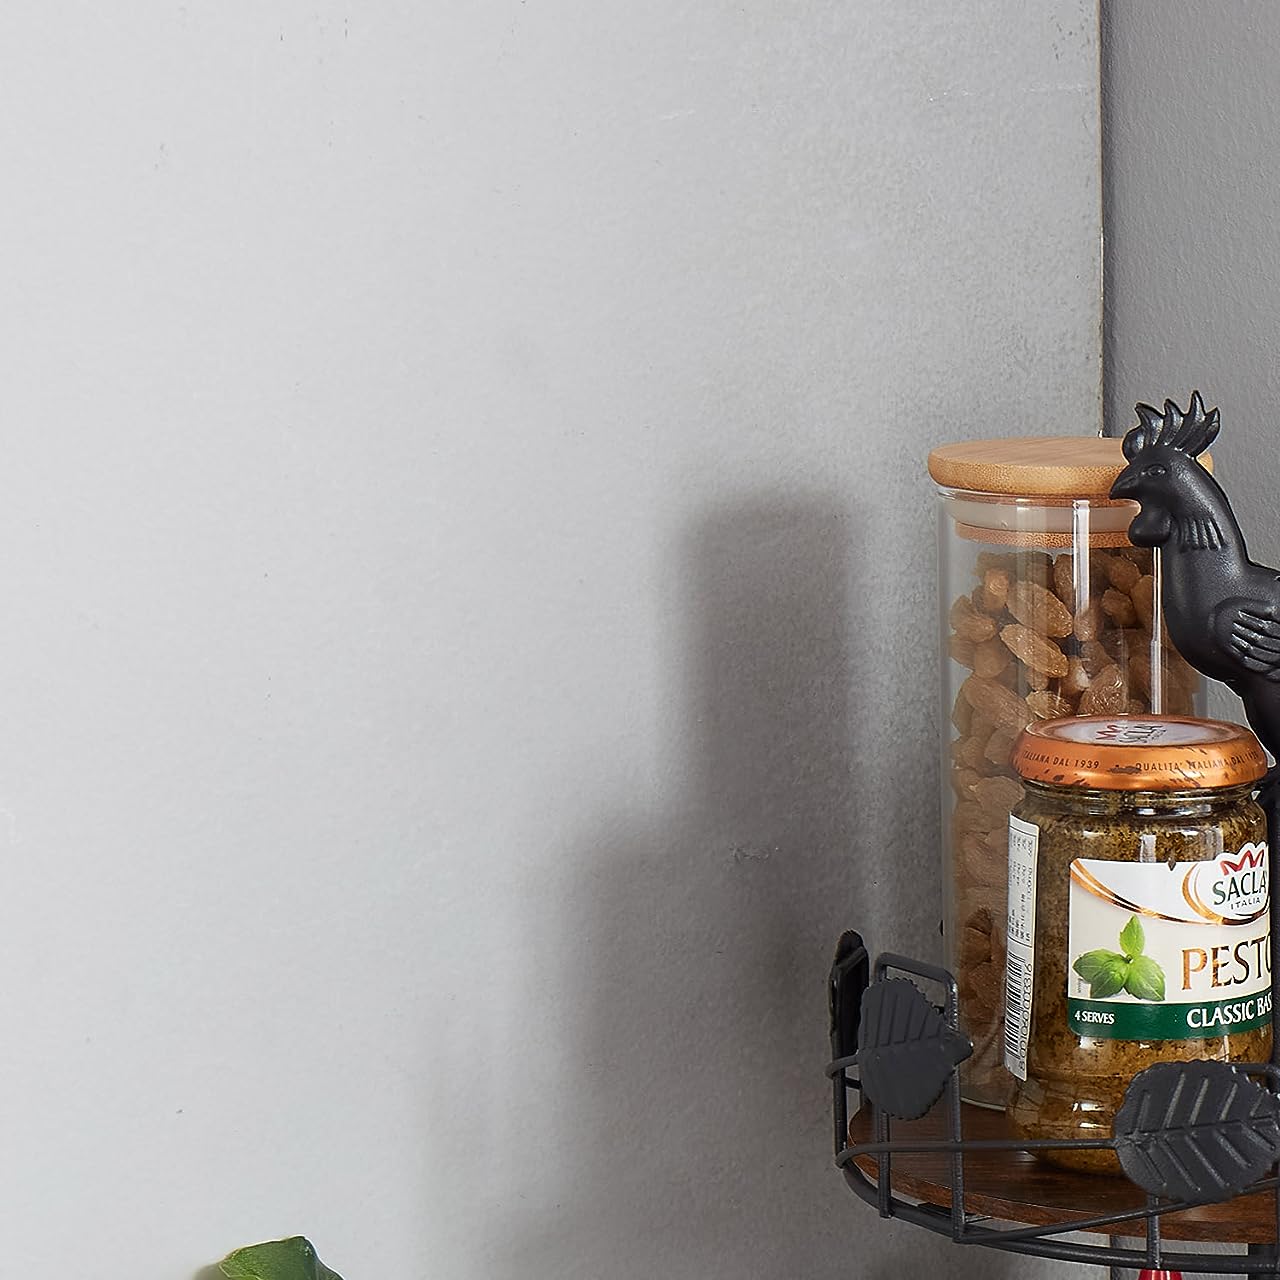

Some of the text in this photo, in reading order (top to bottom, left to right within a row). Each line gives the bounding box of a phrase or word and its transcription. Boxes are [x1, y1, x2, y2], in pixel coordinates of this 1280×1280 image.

[1052, 756, 1070, 767] DAL
[1074, 759, 1100, 769] 1939
[1230, 897, 1261, 910] ITALIA
[1074, 1010, 1115, 1025] 4 SERVES
[1186, 1001, 1255, 1028] CLASSIC
